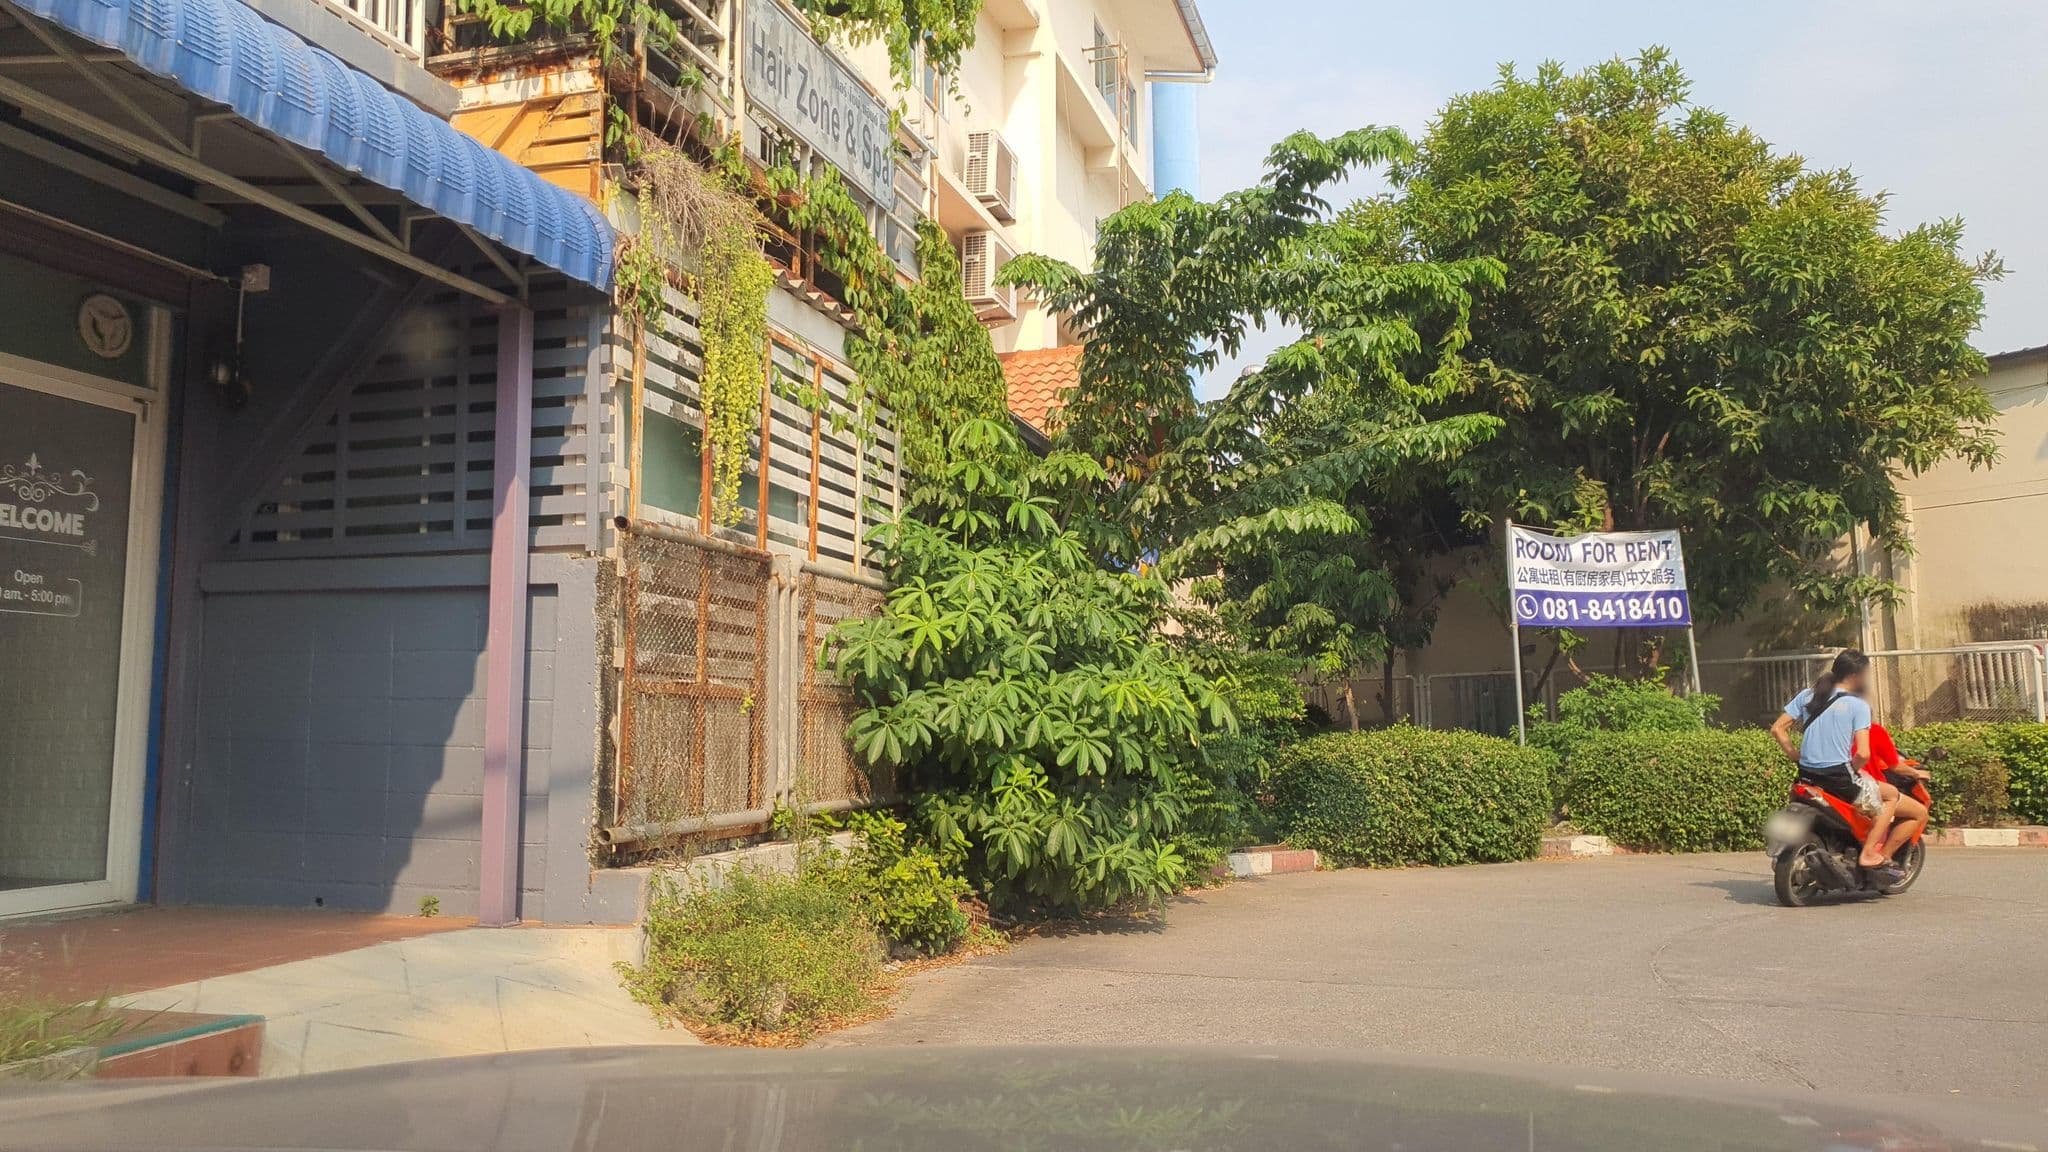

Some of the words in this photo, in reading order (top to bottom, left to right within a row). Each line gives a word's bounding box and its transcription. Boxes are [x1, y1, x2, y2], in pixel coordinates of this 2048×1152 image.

[752, 21, 792, 100] Hair
[796, 62, 840, 143] Zone
[846, 109, 857, 157] &
[861, 124, 890, 188] Spa
[1516, 538, 1572, 562] ROOM
[1582, 542, 1617, 563] FOR
[1625, 540, 1672, 563] RENT
[14, 569, 43, 585] Open
[31, 589, 54, 603] 5:00
[1542, 597, 1683, 621] 081-8418410
